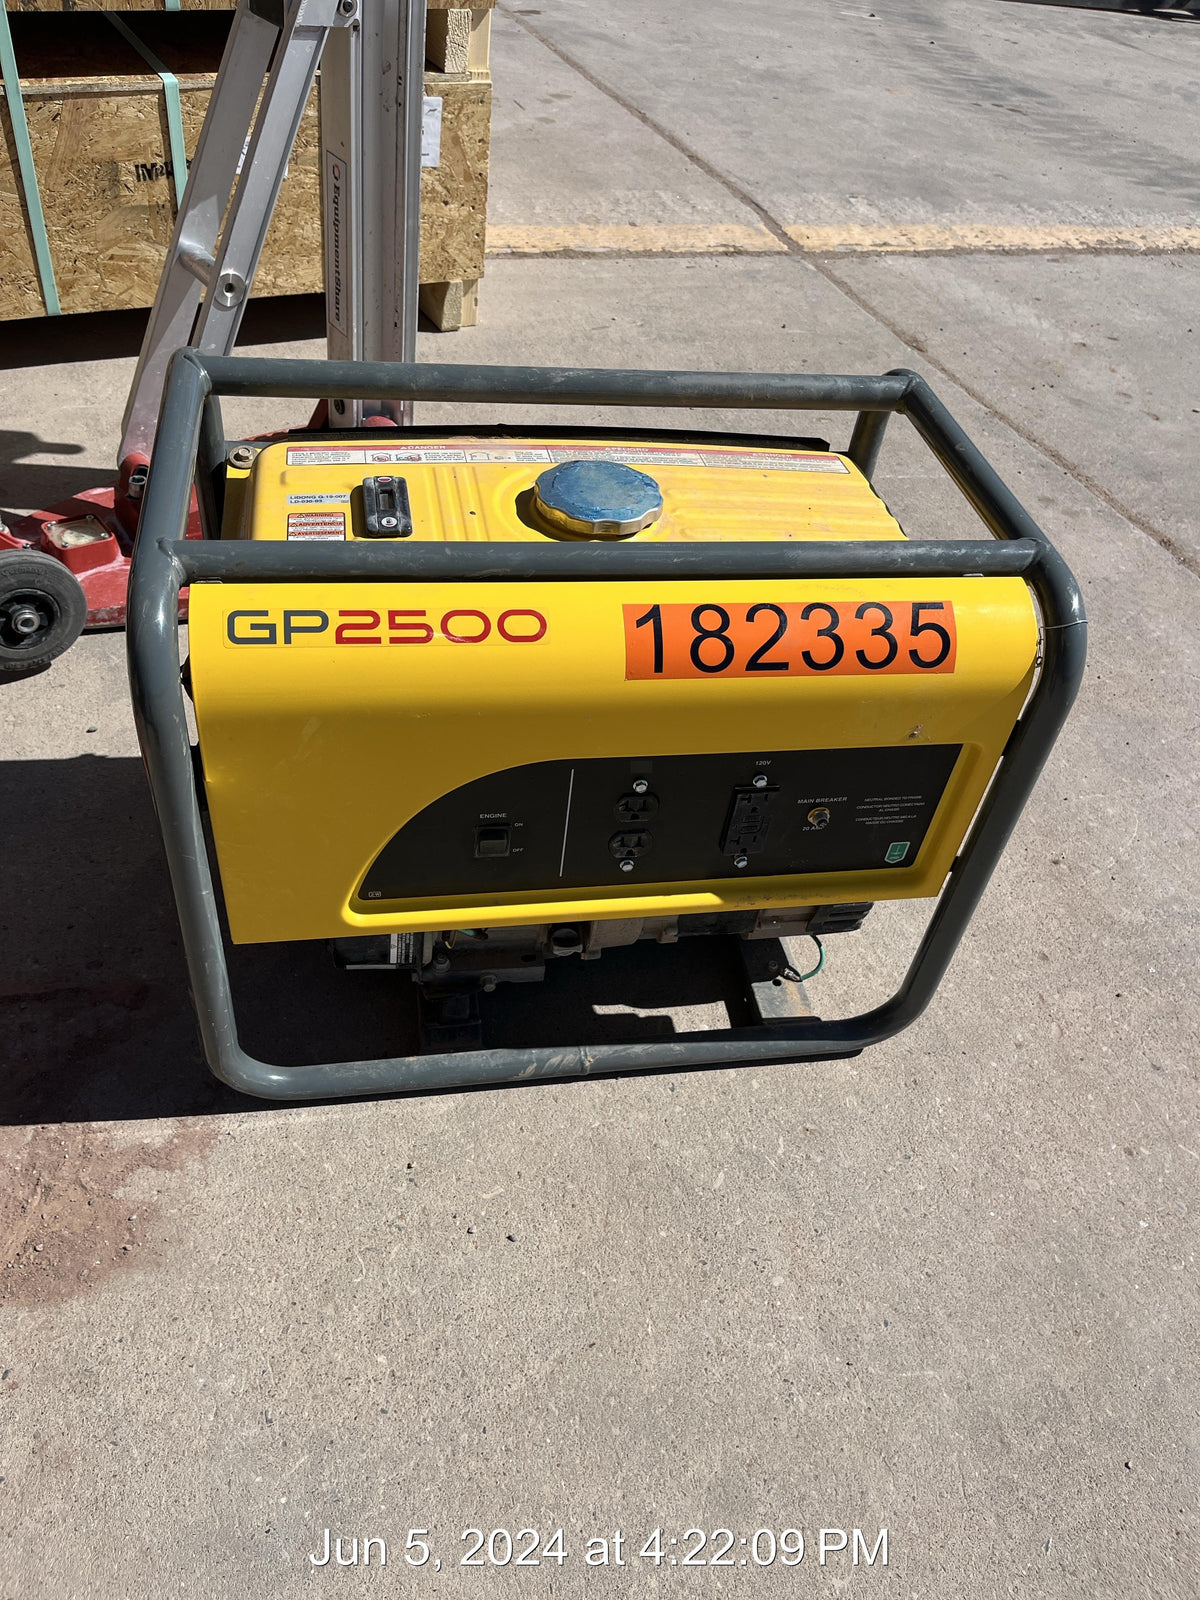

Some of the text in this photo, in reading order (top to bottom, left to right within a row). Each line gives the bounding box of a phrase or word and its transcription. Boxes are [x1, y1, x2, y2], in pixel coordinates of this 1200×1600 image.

[332, 183, 341, 322] EquipmentShare
[227, 609, 548, 645] GP2500
[635, 602, 952, 675] 182335
[815, 796, 848, 804] BREAKER
